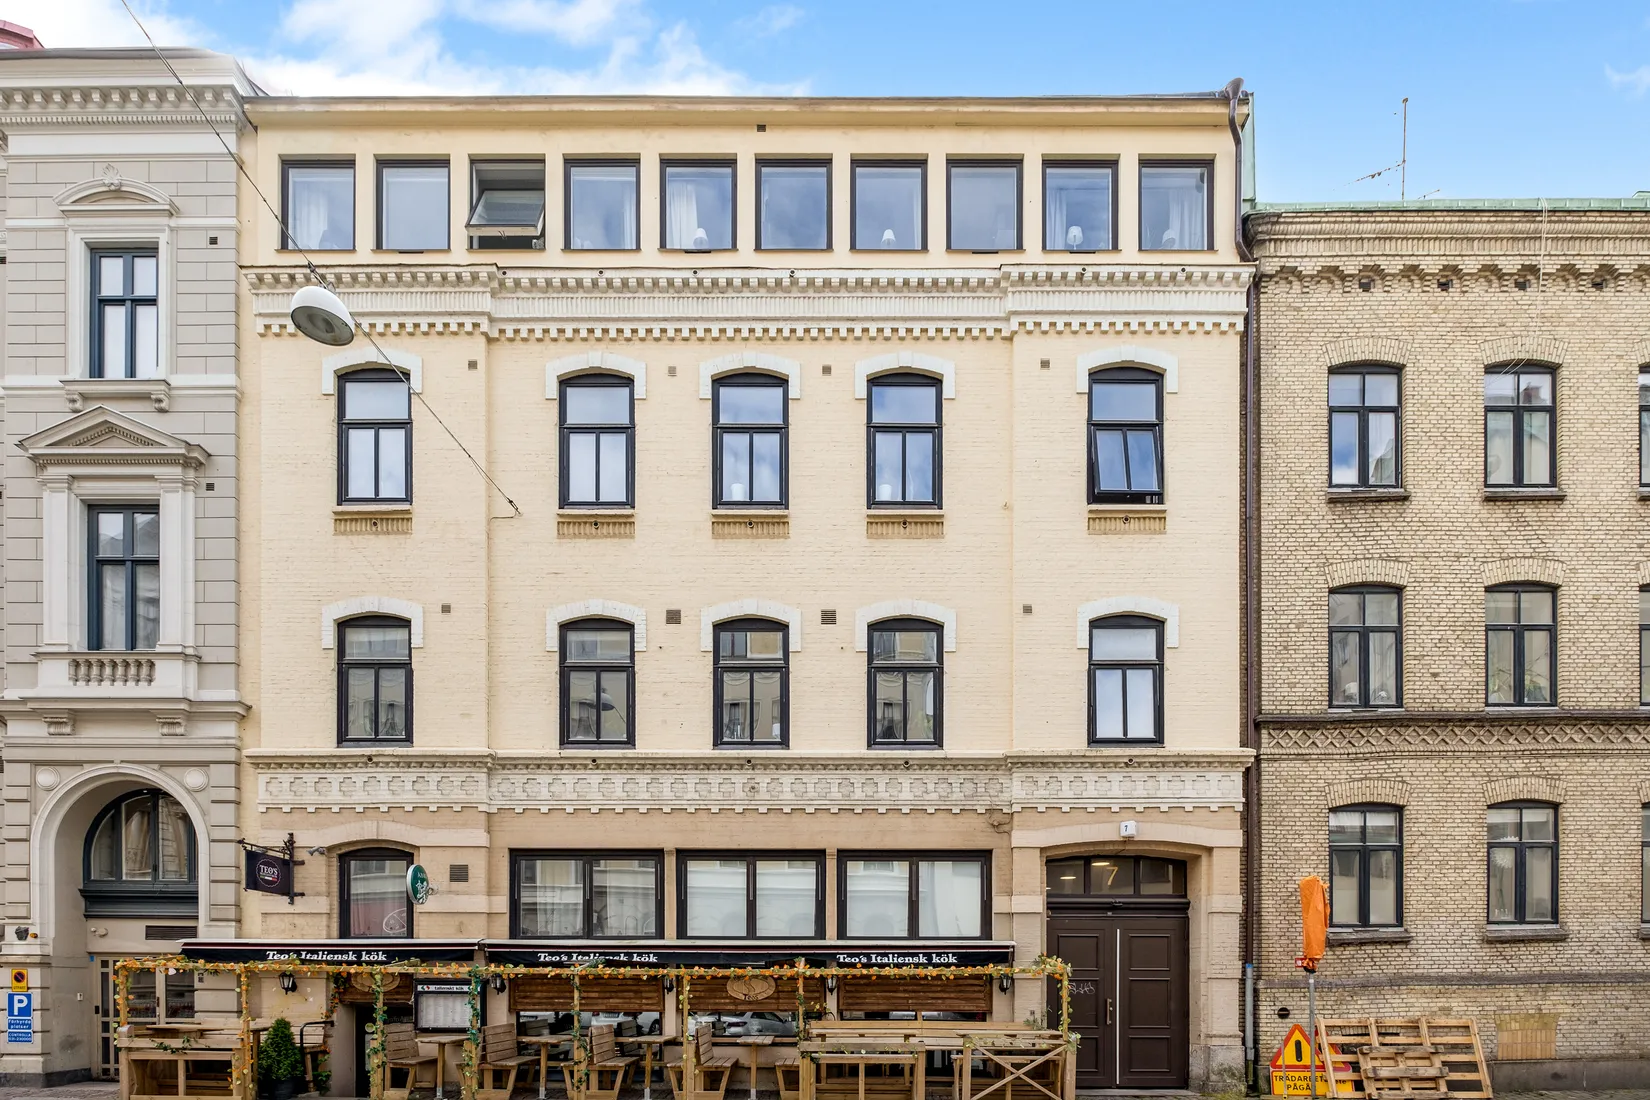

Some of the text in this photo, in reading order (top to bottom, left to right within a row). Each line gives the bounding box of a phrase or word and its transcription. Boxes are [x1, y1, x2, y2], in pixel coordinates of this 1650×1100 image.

[1106, 867, 1118, 885] 7
[300, 951, 357, 960] Italiensk
[361, 951, 387, 960] kök
[632, 953, 658, 962] kök
[870, 954, 928, 963] Italiensk
[932, 954, 957, 963] kök
[14, 995, 28, 1015] P
[1287, 1083, 1316, 1091] PÅGÅ
